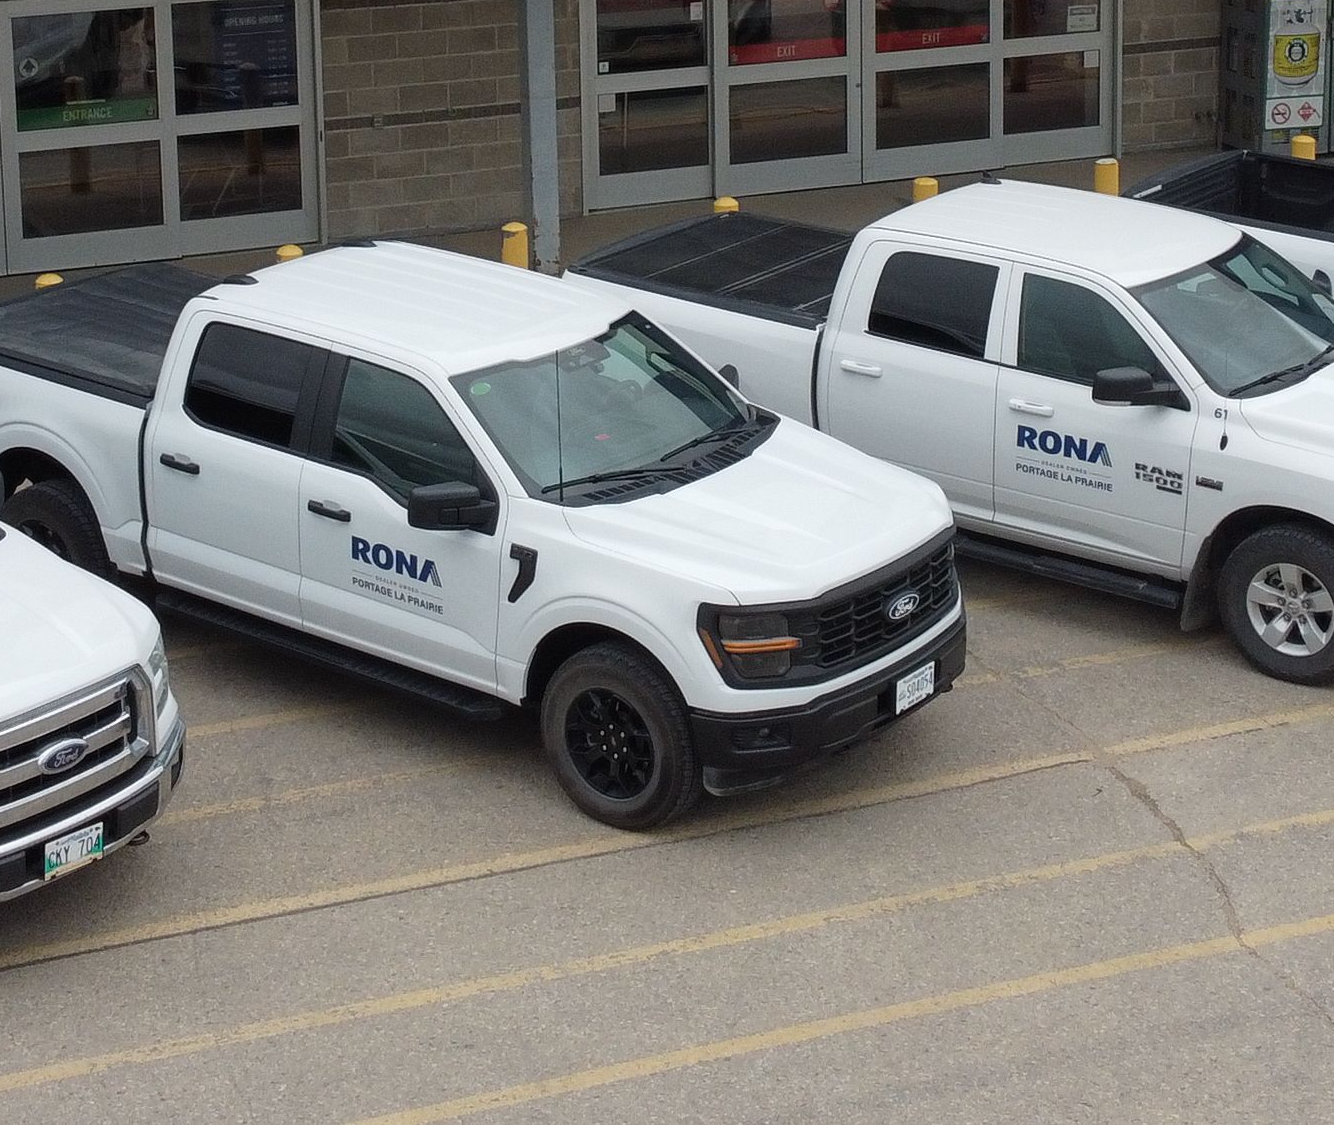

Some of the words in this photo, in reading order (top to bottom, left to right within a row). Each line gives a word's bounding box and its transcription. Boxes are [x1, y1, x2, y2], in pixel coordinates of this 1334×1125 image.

[922, 33, 941, 44] EXIT
[777, 46, 796, 57] EXIT
[62, 107, 113, 122] ENTRANCE
[1214, 408, 1228, 420] 61
[1016, 424, 1113, 468] RONA
[1015, 462, 1059, 481] PORTAGE
[1060, 473, 1074, 484] LA
[1074, 476, 1114, 493] PRAIRIE
[1135, 462, 1183, 481] RAM
[1135, 471, 1183, 490] 1500
[351, 535, 443, 588] RONA
[351, 576, 394, 598] PORTAGE
[394, 590, 407, 603] LA
[407, 595, 444, 616] PRAIRIE
[48, 845, 71, 869] CKY
[78, 833, 101, 857] 704
